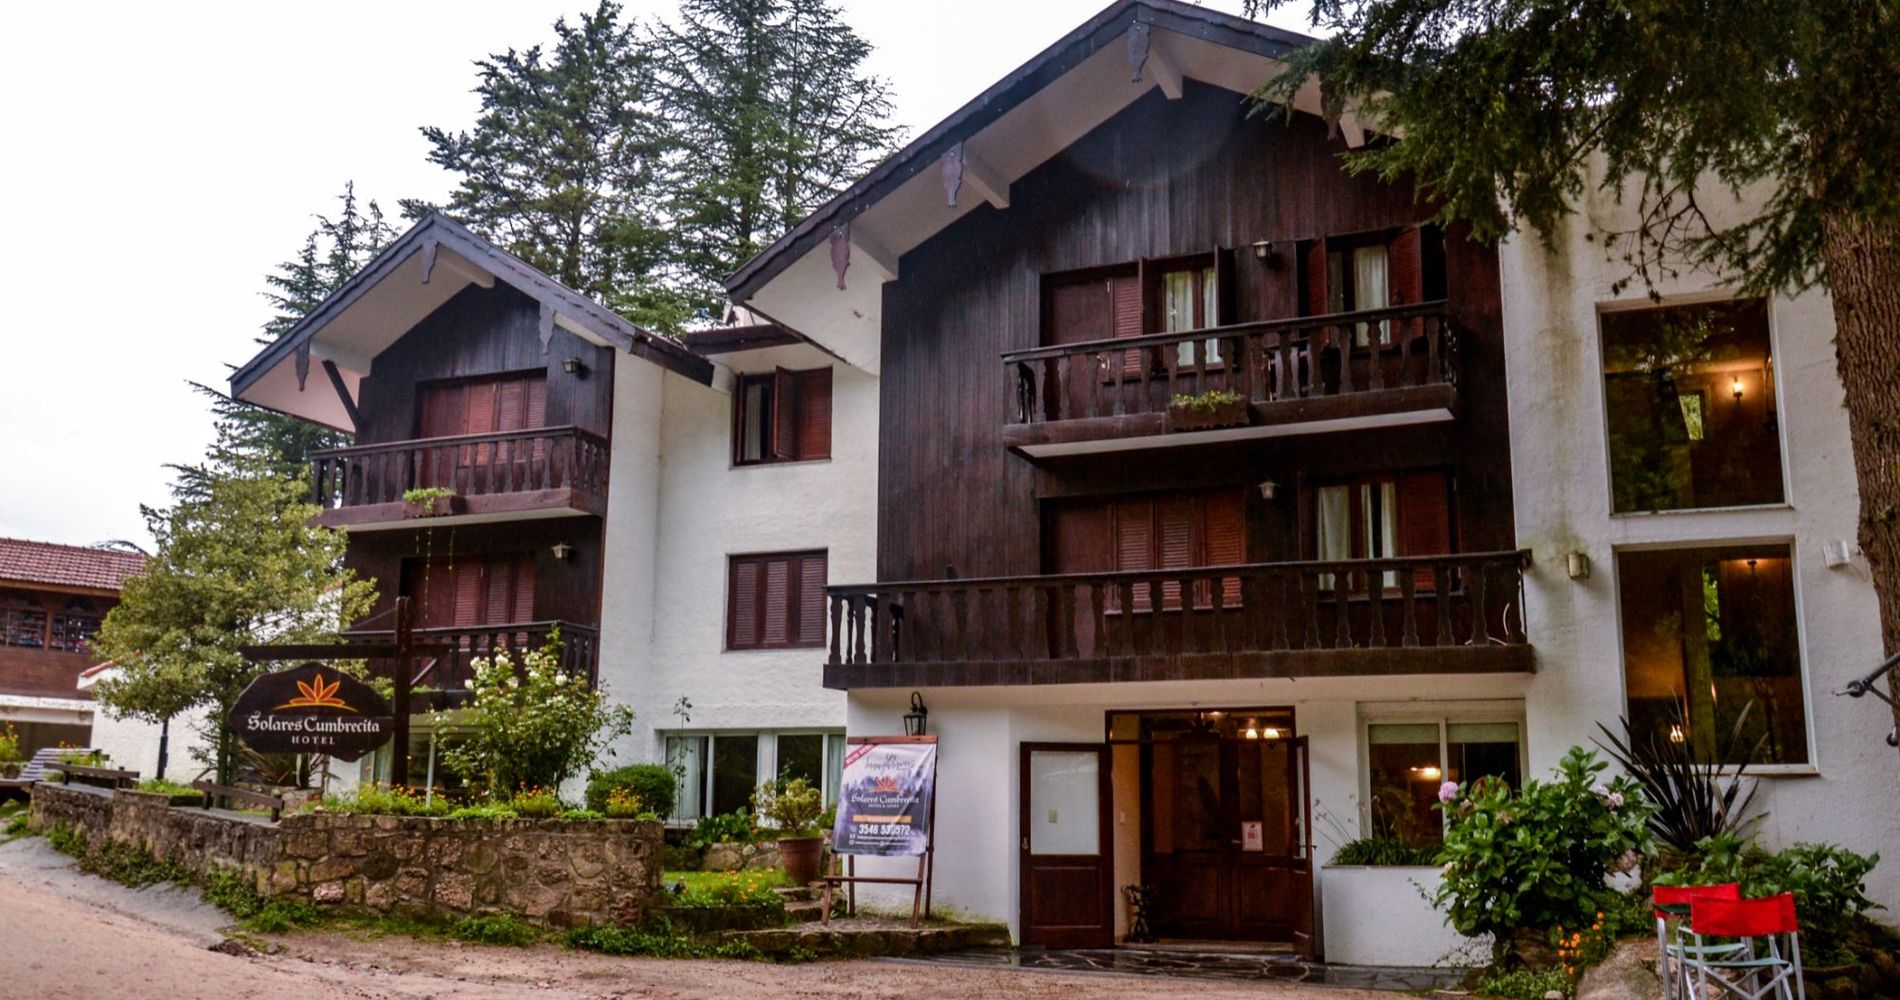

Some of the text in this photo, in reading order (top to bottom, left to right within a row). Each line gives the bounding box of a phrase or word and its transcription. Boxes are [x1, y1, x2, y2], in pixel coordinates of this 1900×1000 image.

[248, 711, 380, 732] Solares Cumbrecita
[291, 735, 336, 745] HOTEL
